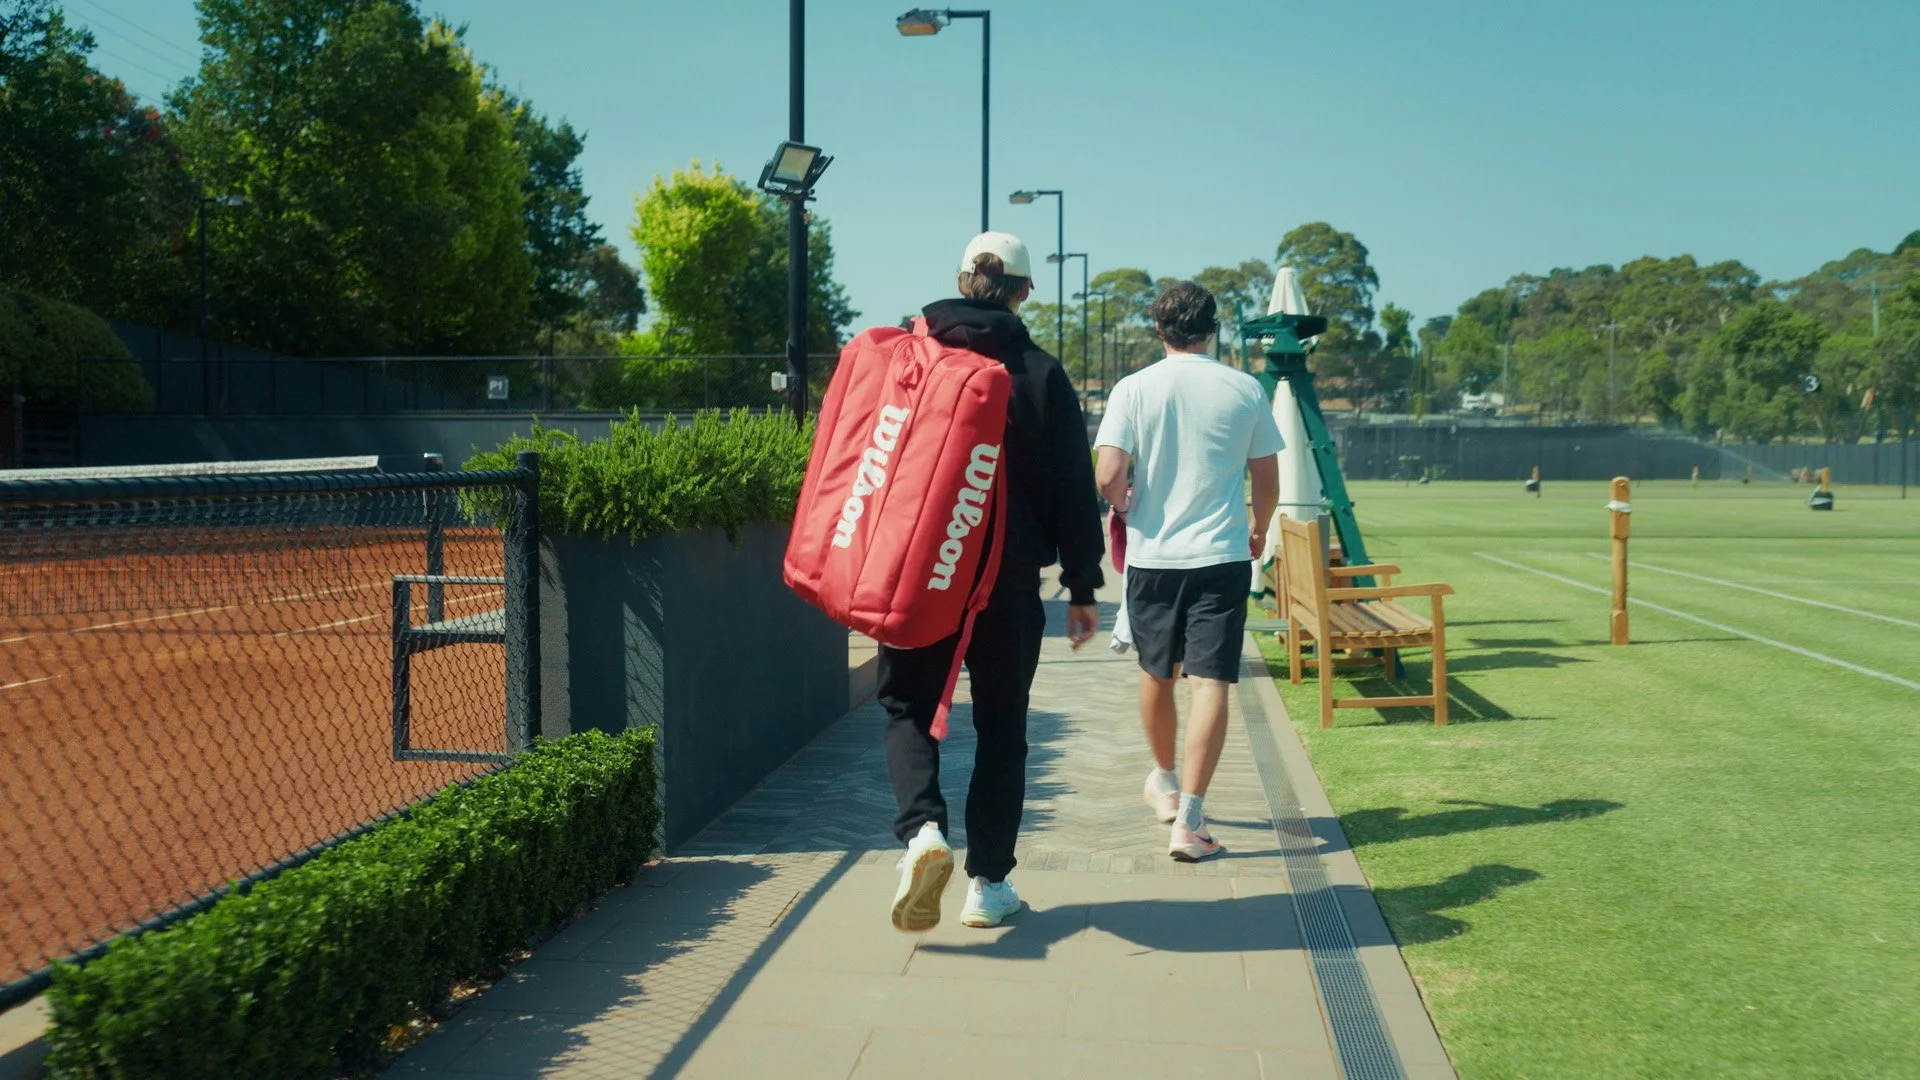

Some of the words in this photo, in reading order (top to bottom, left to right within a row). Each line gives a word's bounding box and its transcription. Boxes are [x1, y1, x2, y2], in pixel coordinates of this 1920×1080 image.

[1805, 375, 1819, 392] 3
[833, 404, 909, 549] Wilson
[928, 444, 1000, 591] Wilson
